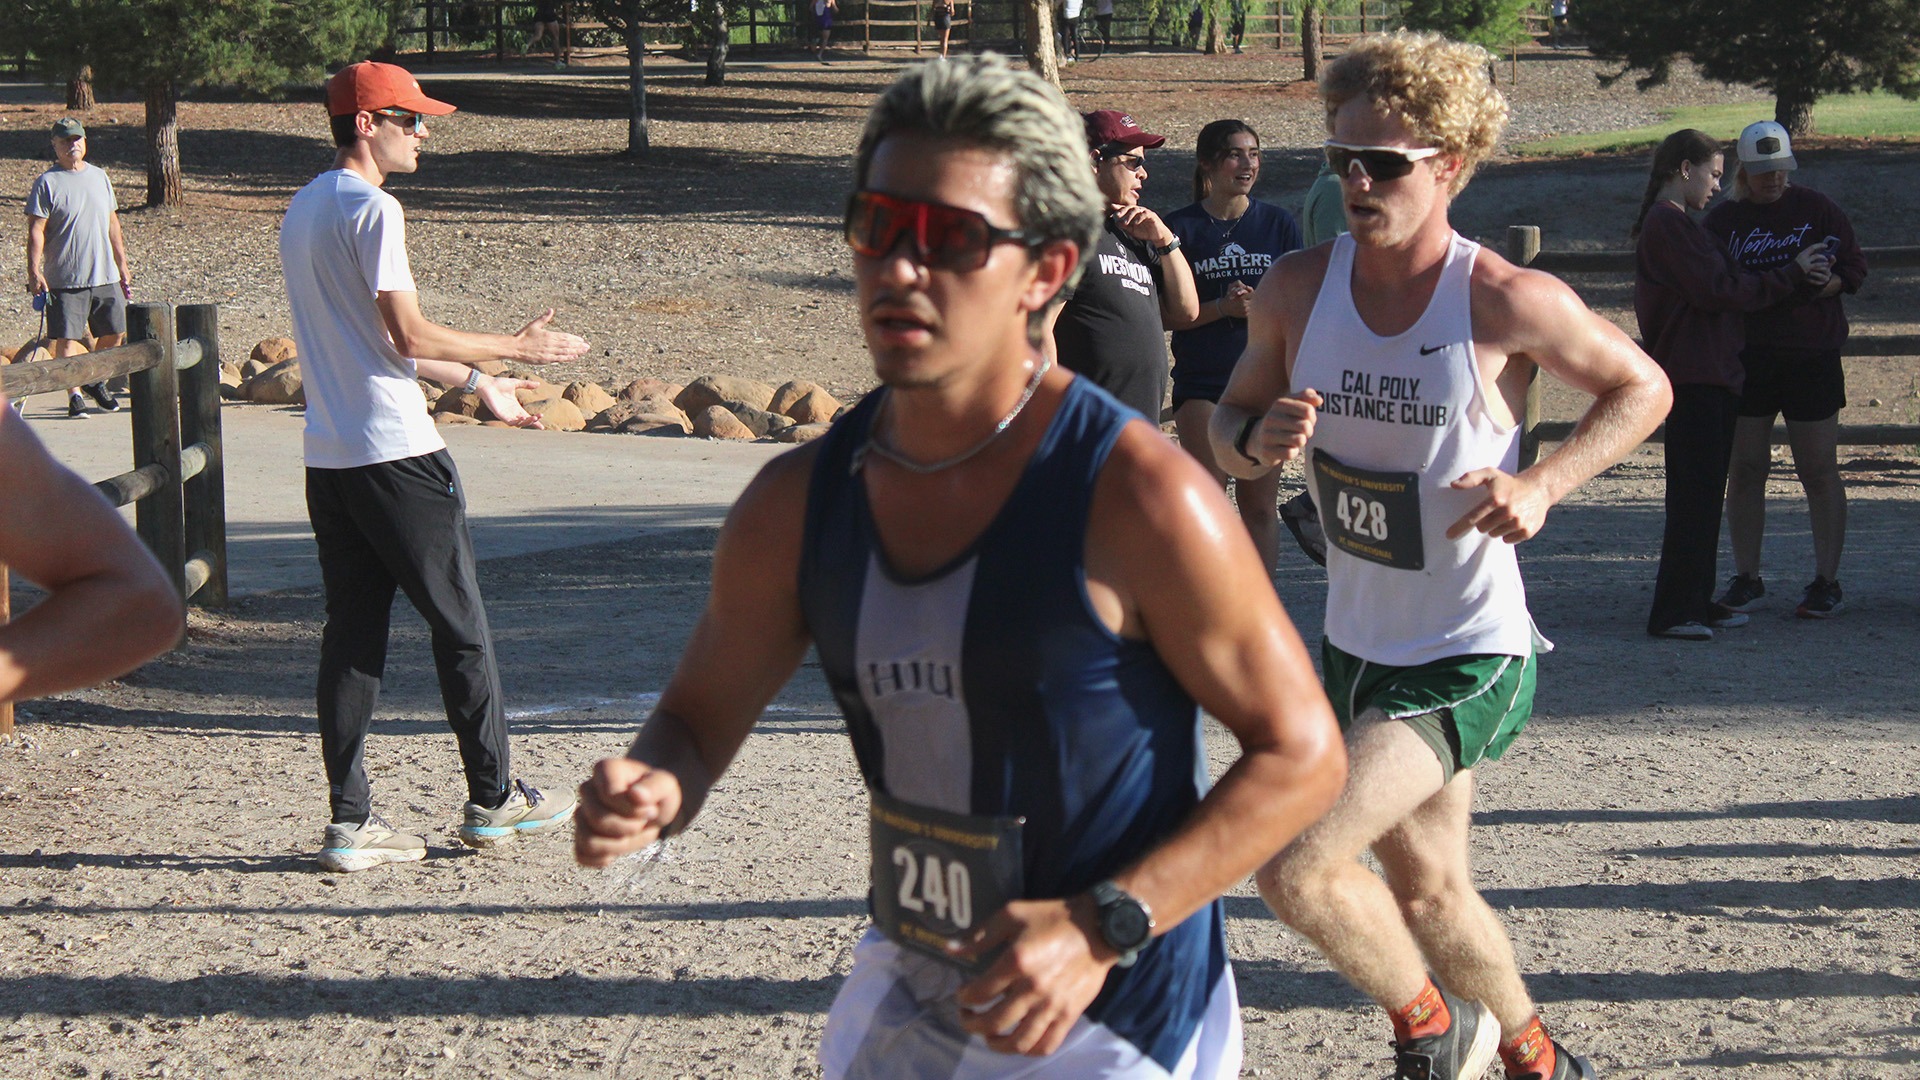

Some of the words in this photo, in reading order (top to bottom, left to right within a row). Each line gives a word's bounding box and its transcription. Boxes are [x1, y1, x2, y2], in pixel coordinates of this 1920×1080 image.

[1727, 223, 1812, 260] Westmont
[1194, 253, 1272, 275] MASTER'S
[1205, 270, 1232, 280] TRACK
[1242, 268, 1263, 276] FIELD
[1745, 254, 1789, 264] COLLEGE
[1341, 369, 1374, 396] CAL
[1316, 390, 1395, 423] DISTANCE
[1401, 403, 1447, 427] CLUB
[1336, 490, 1389, 541] 428
[891, 845, 973, 930] 240
